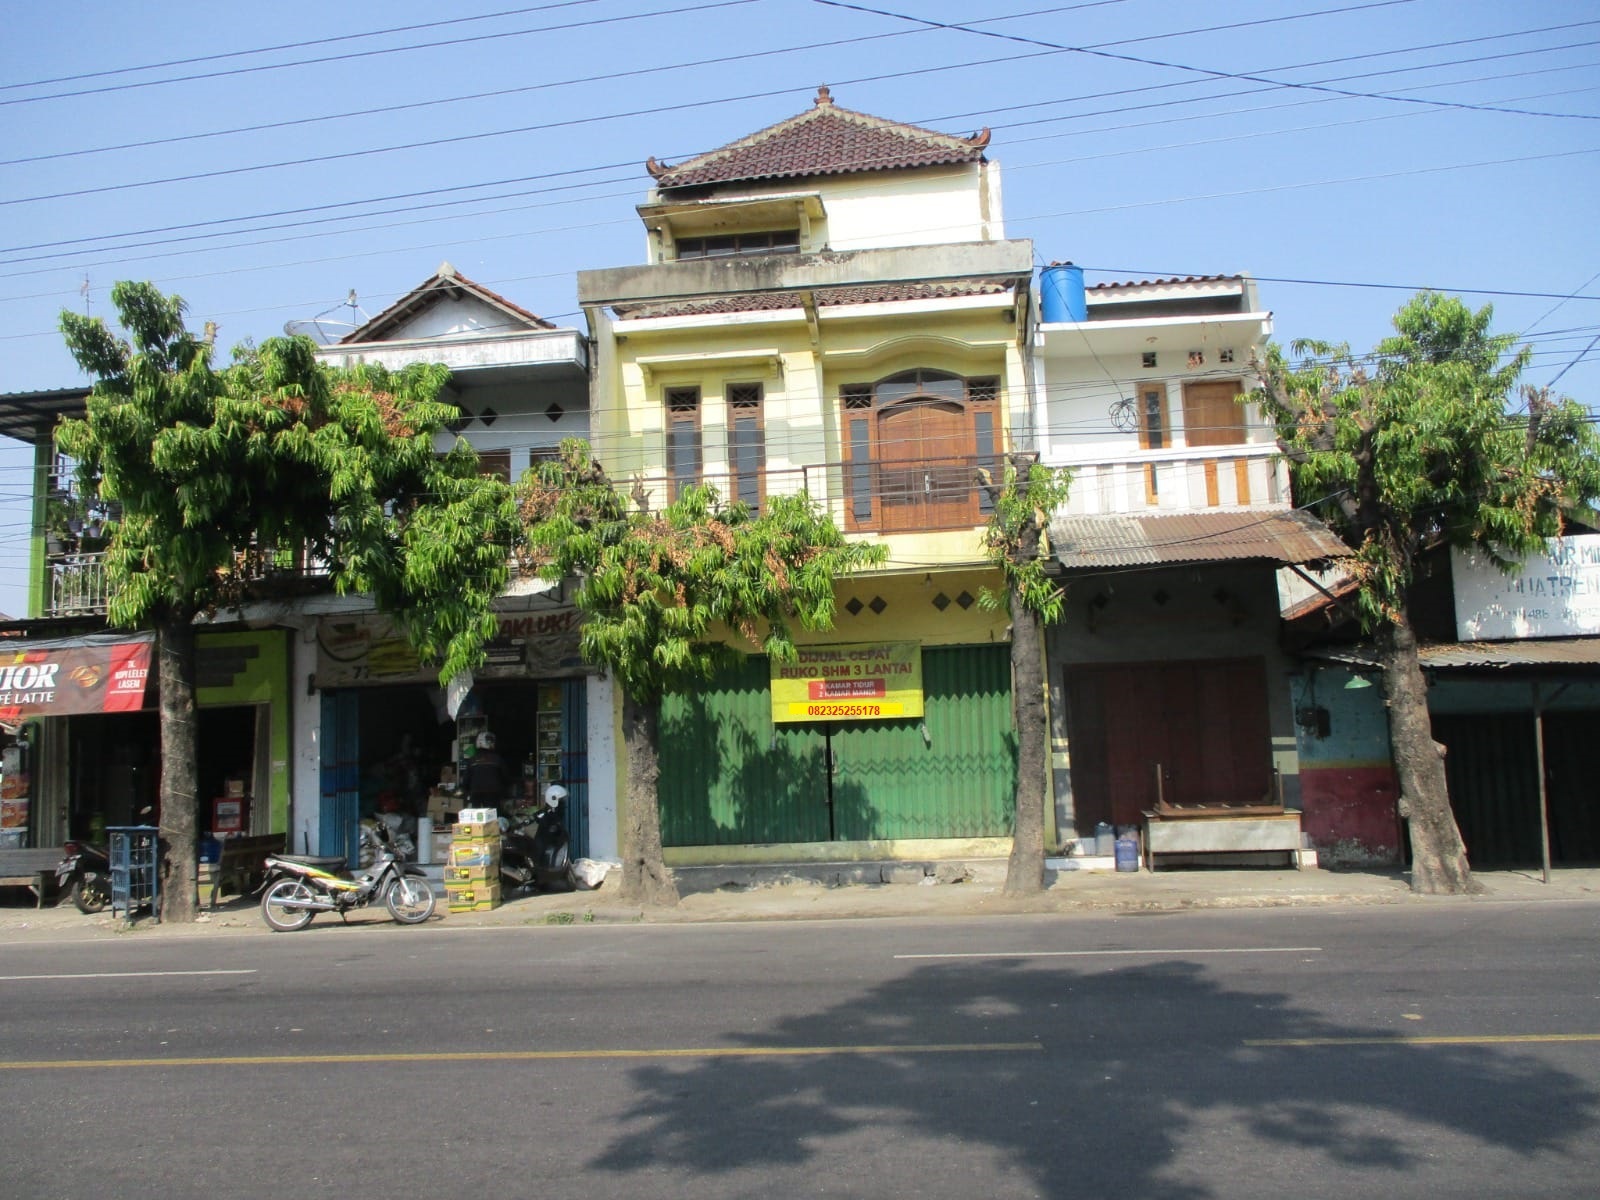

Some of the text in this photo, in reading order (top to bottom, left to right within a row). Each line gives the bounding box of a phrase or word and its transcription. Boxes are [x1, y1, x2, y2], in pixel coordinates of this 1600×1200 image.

[799, 648, 891, 664] DIJUAL CEPAT
[780, 663, 912, 678] RUKO SHM 3 LANTAI
[825, 682, 851, 690] KAMAR
[853, 681, 875, 689] TIDUR
[15, 691, 55, 704] LATTE
[825, 689, 851, 698] KAMAR
[852, 688, 876, 697] MANDI
